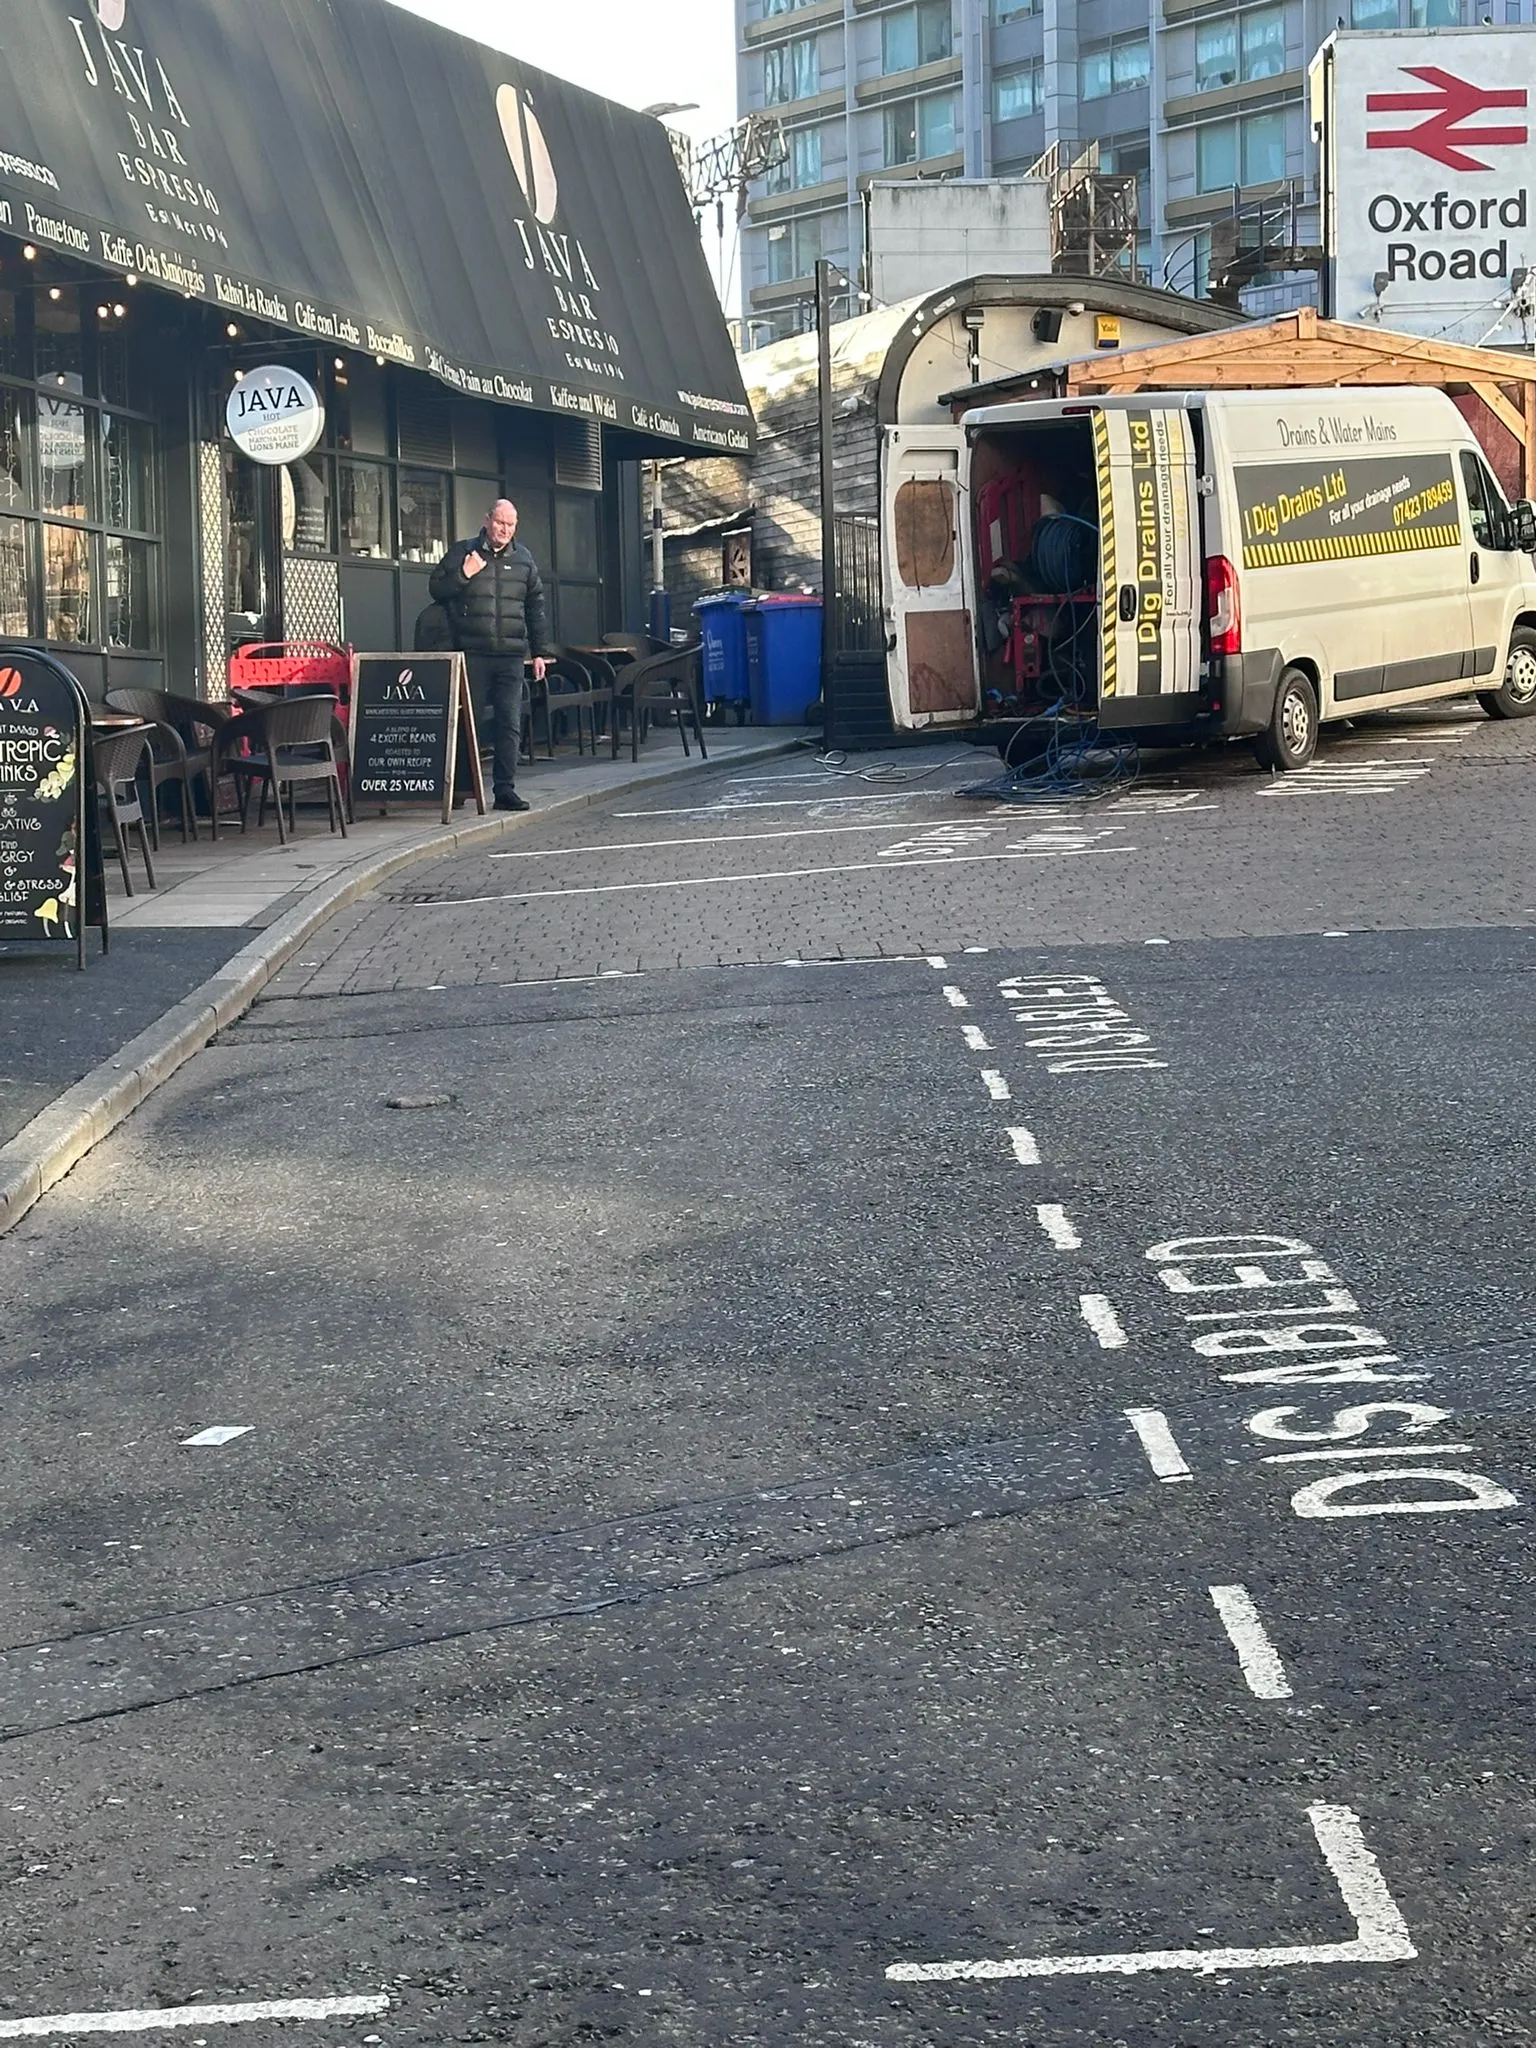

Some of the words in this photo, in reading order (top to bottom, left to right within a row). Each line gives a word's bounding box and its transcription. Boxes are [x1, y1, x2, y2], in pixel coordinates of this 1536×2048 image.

[68, 16, 190, 128] JAVA
[127, 111, 187, 166] BAR
[1368, 189, 1527, 233] Oxford
[100, 231, 134, 268] Kaffe
[135, 243, 161, 278] Och
[514, 218, 600, 291] JAVA
[1387, 240, 1507, 282] Road
[213, 273, 244, 308] Kahvi
[554, 285, 598, 321] BAR
[238, 385, 305, 417] JAVA
[459, 367, 481, 392] Pain
[494, 375, 534, 403] Chocolat
[550, 385, 577, 410] Kaffee
[248, 424, 298, 436] CHOCOLATE
[263, 413, 280, 421] HOT
[655, 412, 680, 437] Comida
[1276, 417, 1317, 448] Drains
[1318, 416, 1330, 445] &
[1328, 416, 1362, 444] Water
[1362, 415, 1397, 442] Mains
[1130, 421, 1153, 469] Ltd
[1155, 420, 1167, 463] needs
[1160, 465, 1171, 525] drainage
[1244, 510, 1252, 539] I
[1252, 502, 1279, 536] Dig
[1278, 486, 1323, 523] Drains
[1322, 467, 1348, 502] Ltd
[1328, 508, 1341, 526] For
[1341, 502, 1350, 520] all
[1350, 498, 1365, 520] your
[1364, 485, 1392, 509] drainage
[1391, 474, 1412, 496] needs
[1392, 495, 1421, 527] 07423
[1421, 479, 1454, 513] 789459
[1137, 480, 1158, 581] Drains
[1164, 528, 1174, 559] your
[1164, 563, 1172, 579] all
[1165, 582, 1174, 606] For
[1138, 592, 1162, 643] Dig
[383, 685, 426, 700] JAVA
[370, 733, 377, 743] 4
[378, 733, 407, 744] EXOTIC
[409, 733, 437, 743] BEANS
[368, 757, 385, 767] OUR
[387, 757, 405, 767] OWN
[407, 757, 432, 767] RECIPE
[361, 779, 387, 792] OVER
[388, 779, 402, 792] 25
[403, 779, 435, 792] YEARS
[17, 879, 63, 890] STRESS
[996, 974, 1169, 1074] DISABLED
[1145, 1234, 1519, 1519] DISABLED
